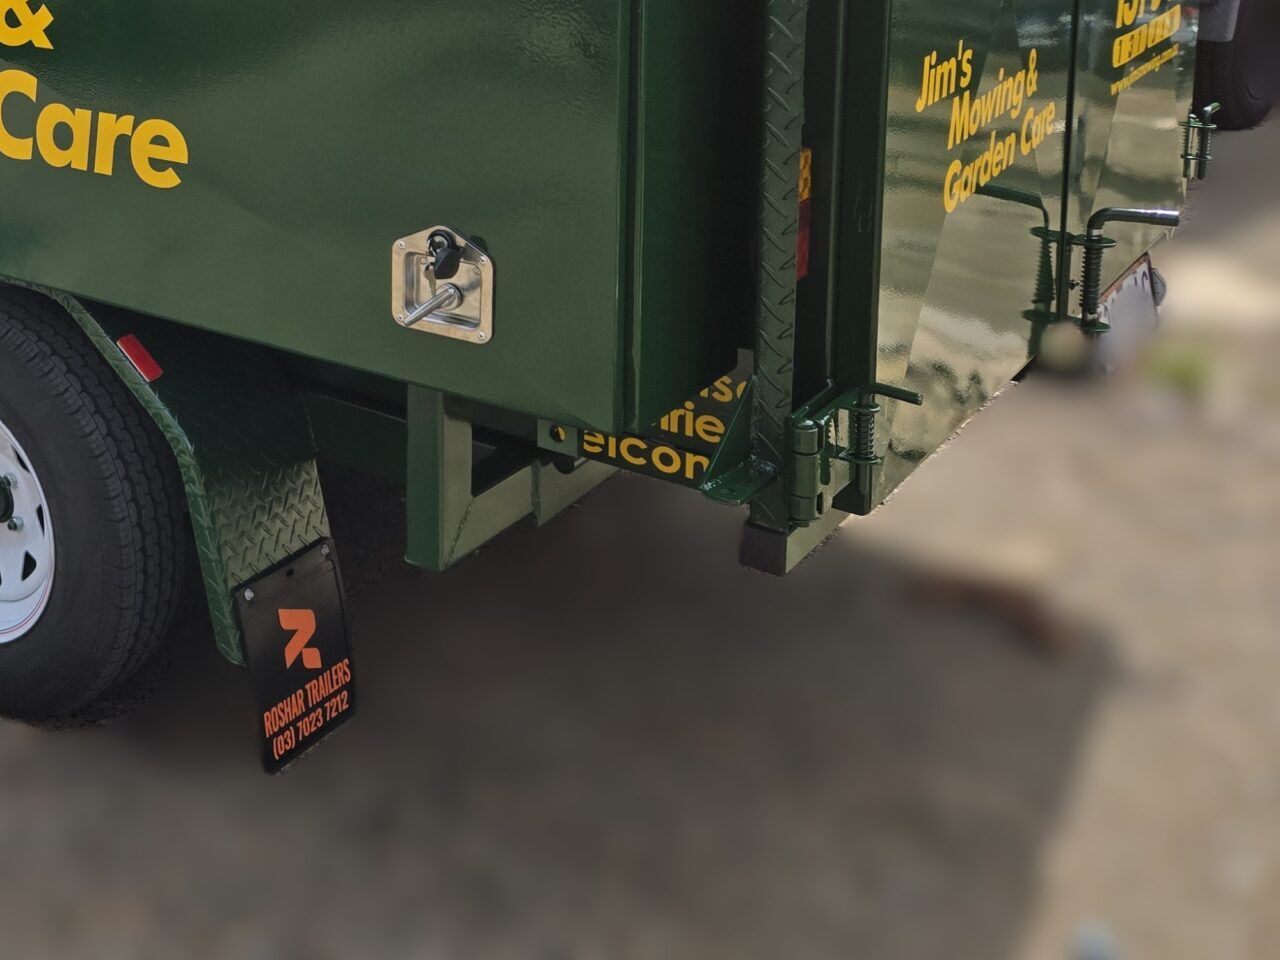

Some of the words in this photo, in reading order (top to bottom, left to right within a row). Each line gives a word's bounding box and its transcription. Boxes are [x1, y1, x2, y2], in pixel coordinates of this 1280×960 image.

[916, 40, 973, 113] Jim's
[947, 67, 1026, 150] Mowing
[1026, 48, 1038, 97] &
[943, 130, 1017, 213] Garden
[1020, 101, 1056, 156] Care
[263, 689, 306, 738] ROSHAR
[304, 657, 351, 708] TRAILERS
[272, 725, 295, 760] (03)
[297, 707, 324, 741] 7023
[325, 690, 349, 721] 7212
